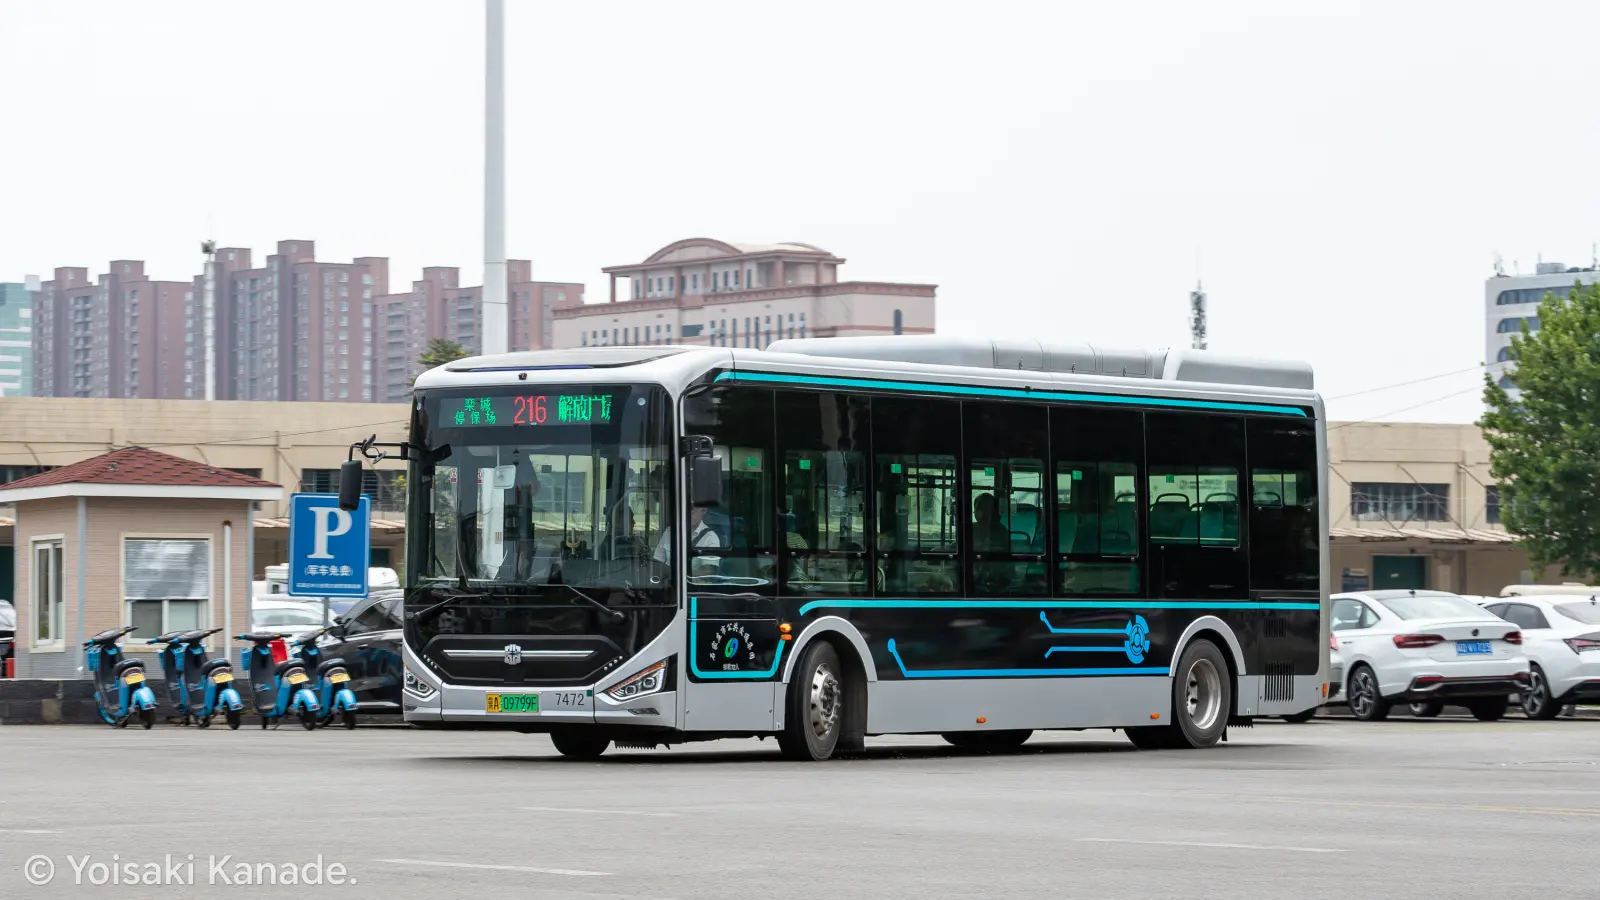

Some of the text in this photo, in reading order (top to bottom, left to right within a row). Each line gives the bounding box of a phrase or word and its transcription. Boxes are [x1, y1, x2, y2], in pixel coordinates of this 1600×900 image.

[454, 411, 497, 425] 停保场
[513, 395, 547, 424] 216
[306, 506, 353, 559] P
[555, 693, 585, 706] 7472
